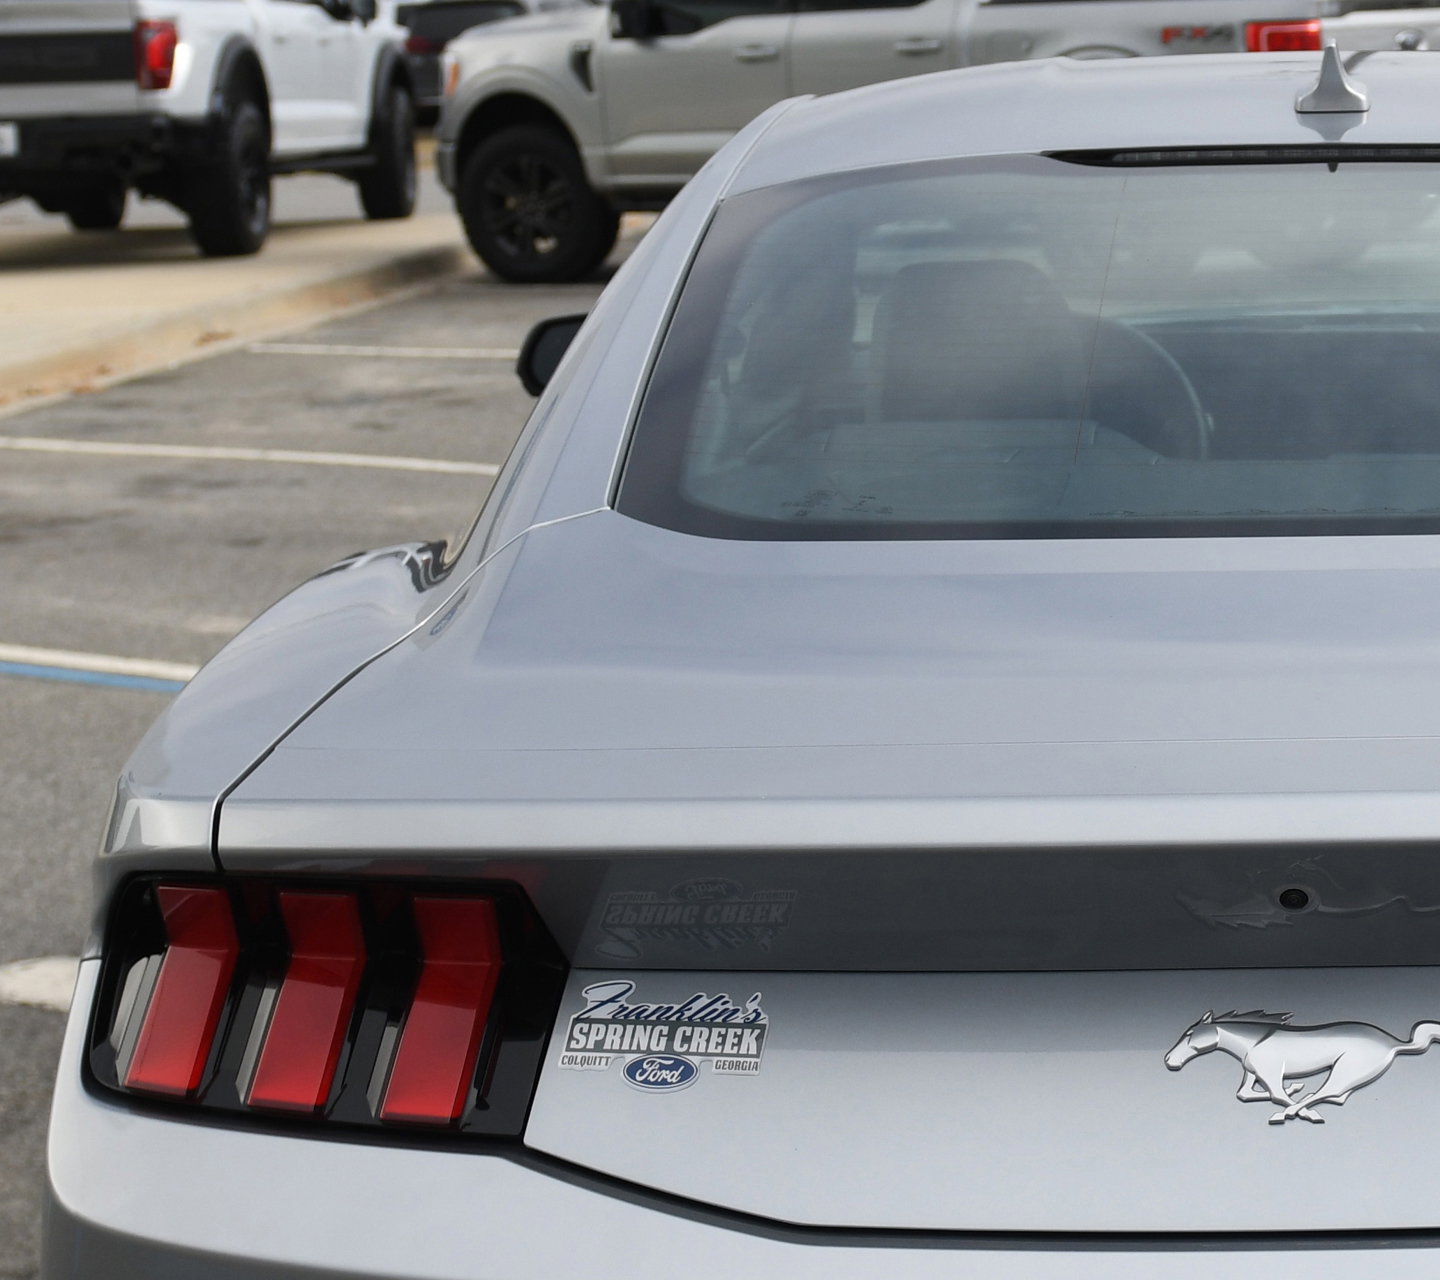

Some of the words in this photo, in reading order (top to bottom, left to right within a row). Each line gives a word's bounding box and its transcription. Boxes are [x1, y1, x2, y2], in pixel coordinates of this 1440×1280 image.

[575, 981, 767, 1023] Franklin's
[570, 1023, 669, 1051] SPRING
[673, 1025, 761, 1055] CREEK
[561, 1055, 611, 1068] COLQUITT
[635, 1058, 681, 1084] Ford
[714, 1059, 759, 1071] GEORGIA
